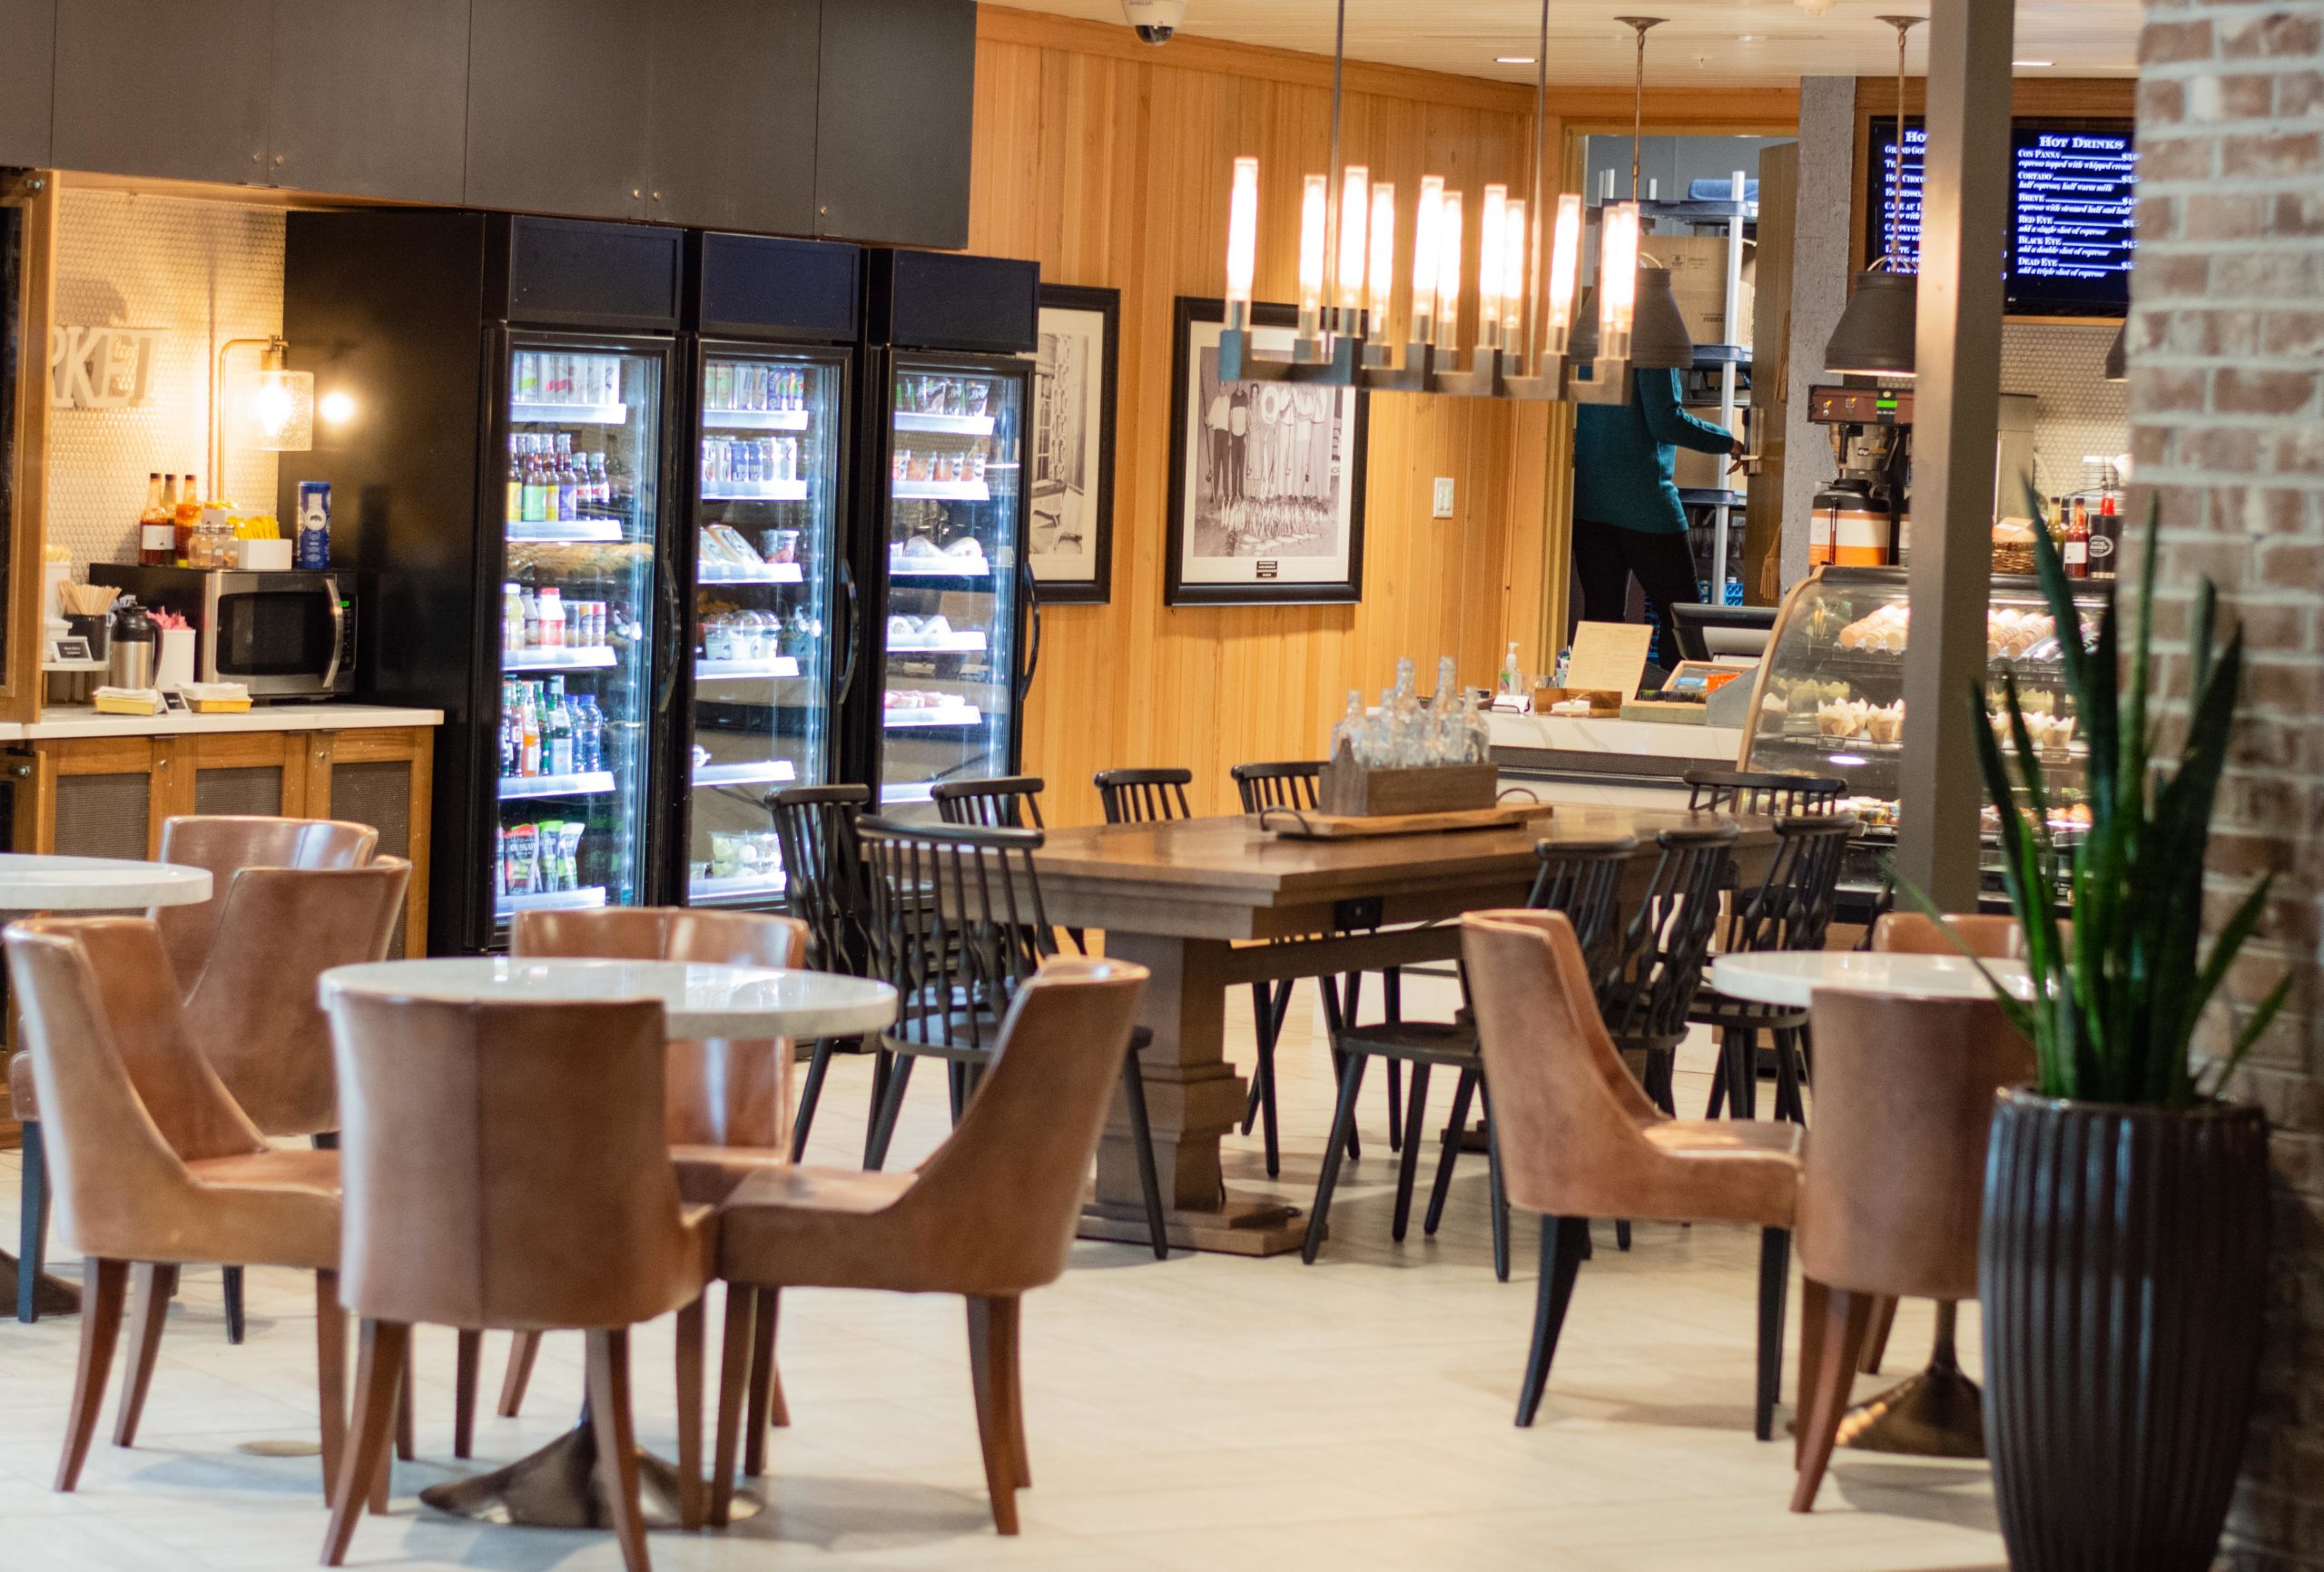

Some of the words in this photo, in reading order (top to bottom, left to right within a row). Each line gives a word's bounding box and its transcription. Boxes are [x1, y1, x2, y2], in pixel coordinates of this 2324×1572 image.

[1905, 131, 1927, 142] HO
[2039, 135, 2069, 148] HOT
[2072, 137, 2125, 150] DRINKS
[1885, 145, 1910, 154] GRND
[2068, 160, 2083, 169] with
[2044, 203, 2061, 212] with
